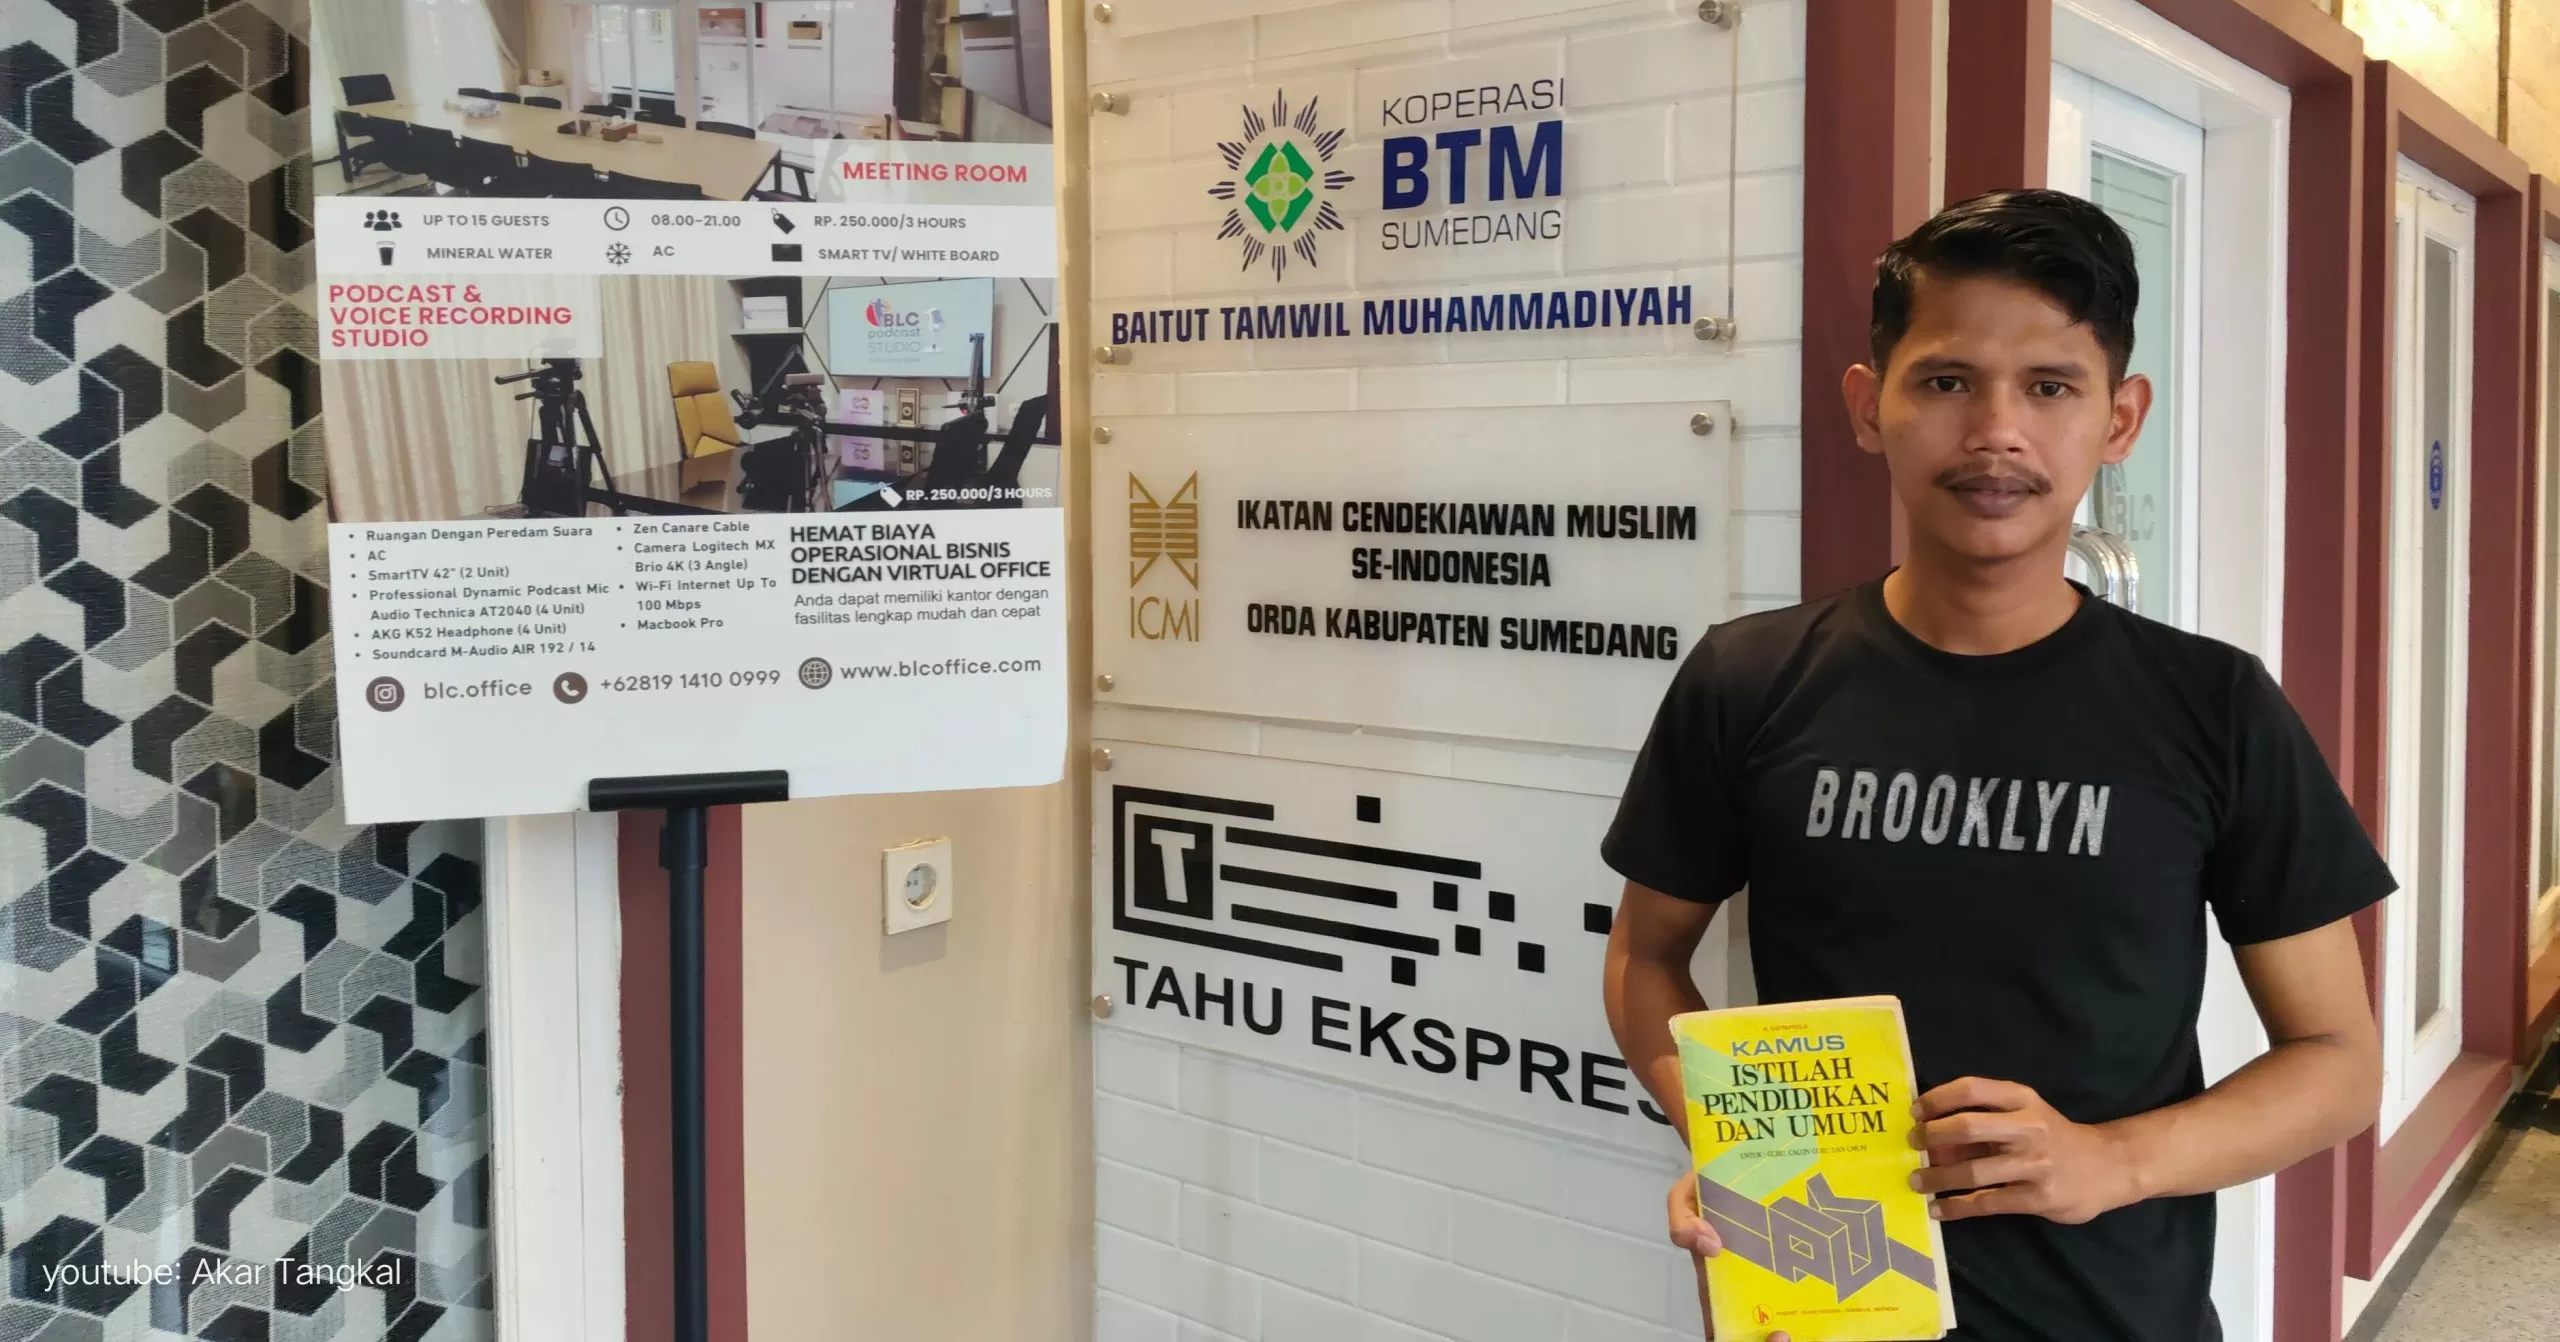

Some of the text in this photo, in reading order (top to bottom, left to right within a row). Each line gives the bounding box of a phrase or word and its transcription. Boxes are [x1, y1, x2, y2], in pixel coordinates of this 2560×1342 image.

[1382, 78, 1565, 126] KOPERASI
[843, 162, 1028, 182] MEETING ROOM
[1382, 120, 1563, 210] BTM
[423, 215, 550, 227] UP TO 15 GUESTS
[814, 213, 966, 230] RP. 250.000/3 HOURS
[1381, 210, 1562, 250] SUMEDANG
[428, 248, 552, 259] MINERAL WATER
[652, 245, 675, 256] AC
[819, 247, 999, 262] SMART TV/ WHITE BOARD
[329, 284, 482, 303] PODCAST &
[330, 307, 572, 325] VOICE RECORDING
[884, 312, 920, 327] BLC
[1112, 286, 1692, 345] BAITUT TAMWIL MUHAMMADIYAH
[331, 329, 428, 347] STUDIO
[868, 328, 921, 338] podcast
[906, 486, 1052, 501] RP. 250.000/3 HOURS
[634, 522, 750, 533] Zen Canare Cable
[1237, 500, 1697, 541] IKATAN CENDEKIAWAN MUSLIM
[367, 526, 592, 542] Ruangan Dengan Peredam Suara
[791, 524, 935, 542] HEMAT BIAYA
[368, 551, 386, 561] AC
[634, 540, 776, 553] Camera Logitech MX
[791, 542, 1010, 563] OPERASIONAL BISNIS
[368, 569, 428, 581] SmartTV
[460, 568, 472, 579] (2
[477, 566, 509, 578] Unit)
[636, 559, 747, 572] Brio 4K (3 Angle)
[792, 562, 1050, 584] DENGAN VIRTUAL OFFICE
[1352, 548, 1551, 587] SE-INDONESIA
[370, 584, 609, 600] Professional Dynamic Podcast Mic
[636, 578, 776, 591] Wi-Fi Internet Up To
[637, 599, 701, 611] 100 Mbps
[794, 588, 1049, 607] Anda dapat memiliki kantor dengan
[371, 603, 584, 620] Audio Technica AT2040 (4 Unit)
[795, 606, 1041, 625] fasilitas lengkap mudah dan cepat
[1130, 596, 1200, 643] ICMI
[372, 623, 566, 639] AKG K52 Headphone (4 Unit)
[637, 618, 724, 630] Macbook Pro
[1247, 603, 1678, 661] ORDA KABUPATEN SUMEDANG
[372, 647, 446, 660] Soundcard
[451, 645, 508, 657] M-Audio
[512, 644, 535, 654] AIR
[540, 642, 564, 653] 192
[580, 641, 596, 652] 14
[840, 658, 1041, 680] www.blcoffice.com
[424, 680, 532, 700] blc.office
[601, 670, 780, 692] +62819 1410 0999
[1806, 769, 2110, 856] BROOKLYN
[1113, 956, 1675, 1127] TAHU EKSPRE
[1732, 1035, 1845, 1057] KAMUS
[1730, 1057, 1855, 1087] ISTILAH
[1702, 1082, 1890, 1116] PENDIDIKAN
[1715, 1110, 1887, 1143] DAN UMUM
